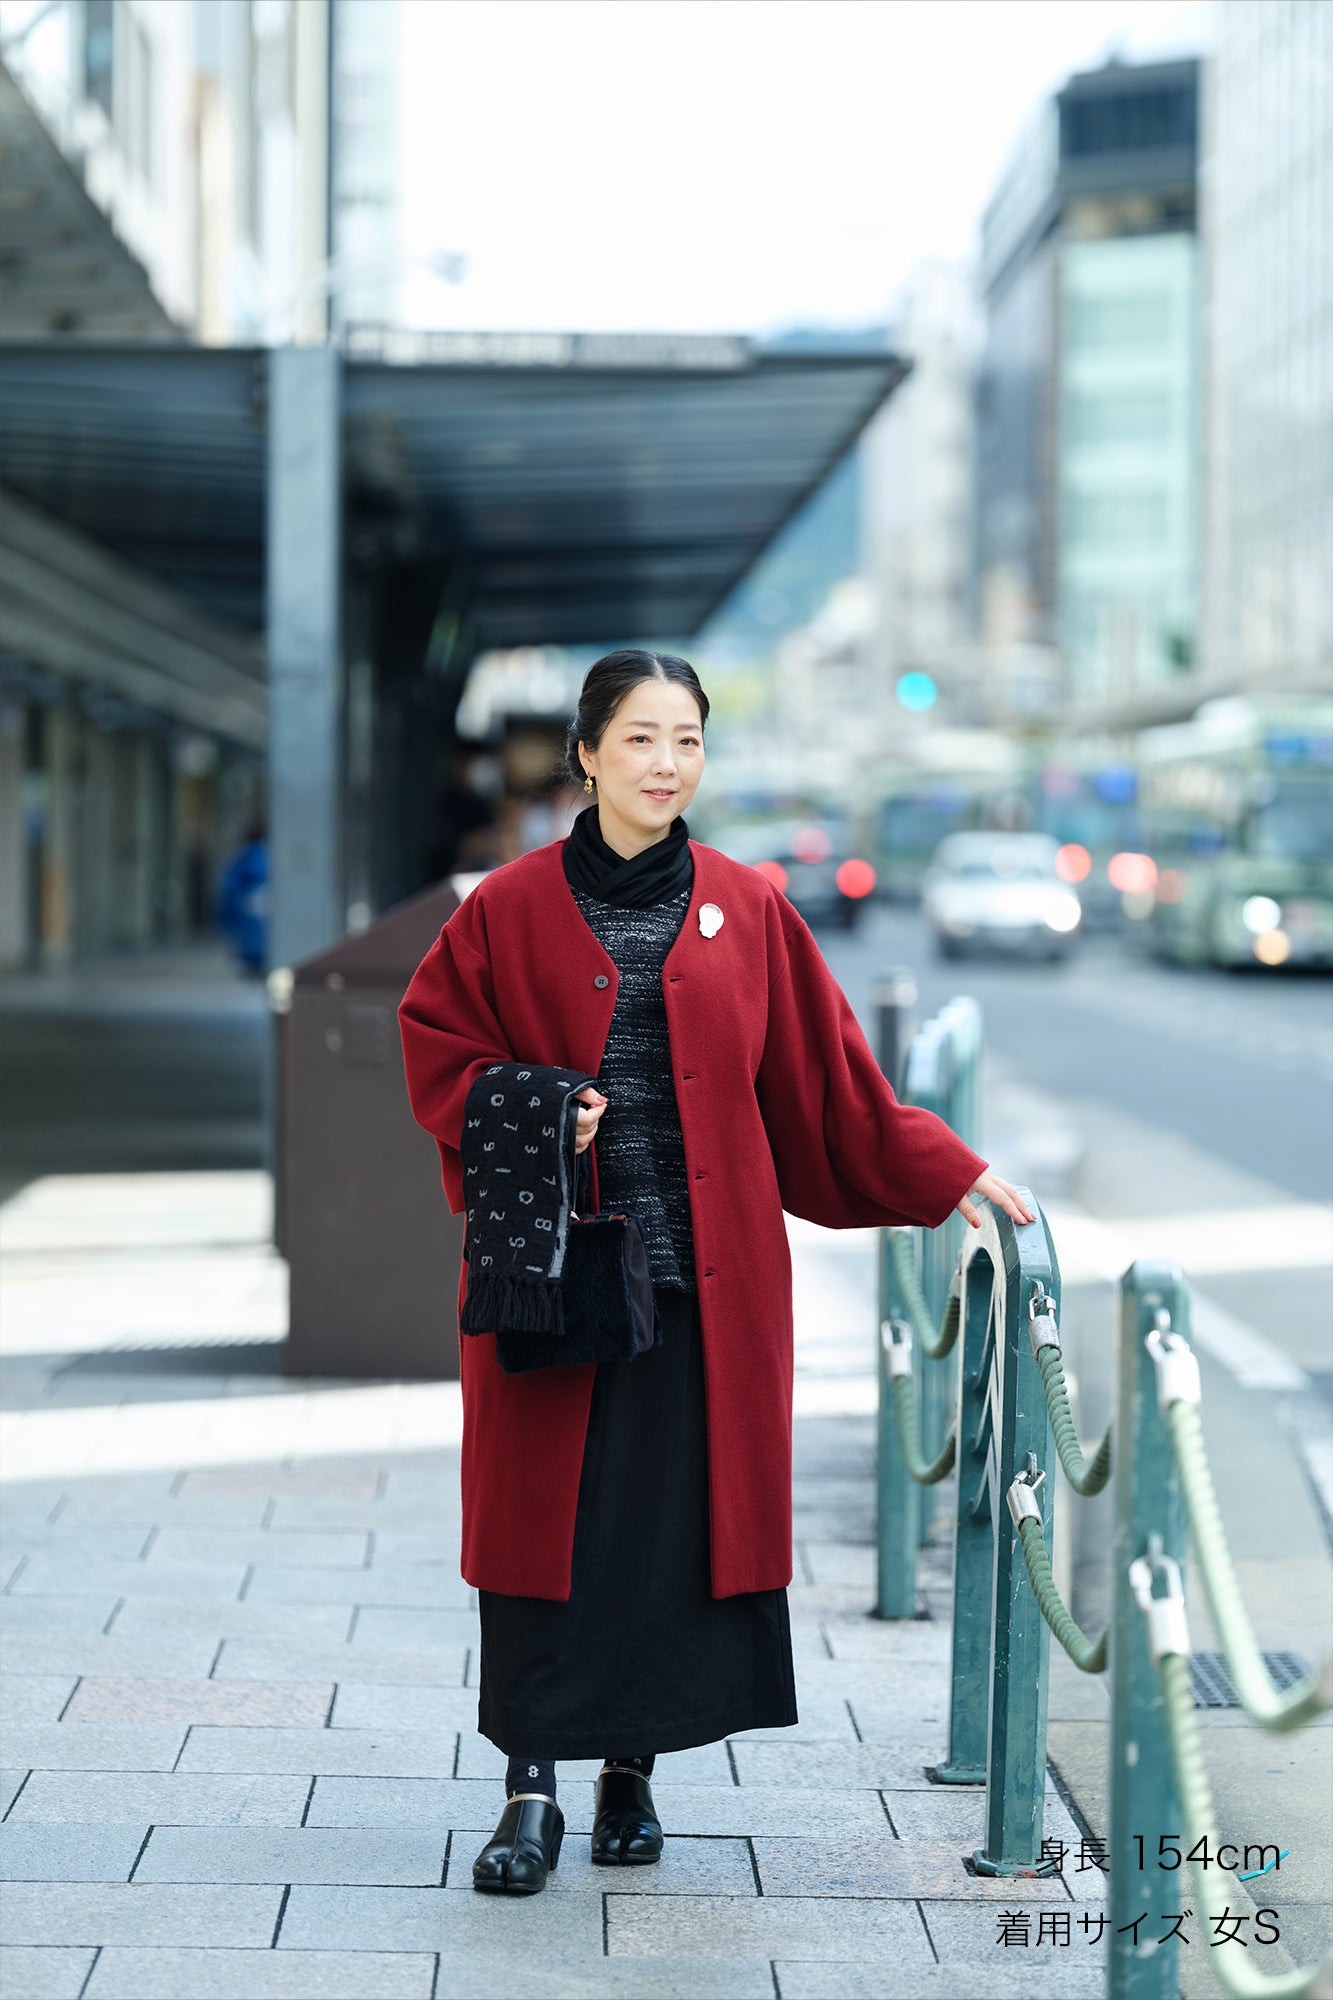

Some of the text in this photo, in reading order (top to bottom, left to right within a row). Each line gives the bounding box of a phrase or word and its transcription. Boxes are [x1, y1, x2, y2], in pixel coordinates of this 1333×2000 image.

[490, 1093, 505, 1107] 0
[528, 1096, 541, 1109] 4
[542, 1126, 555, 1138] 5
[524, 1144, 539, 1155] 3
[466, 1165, 478, 1177] 2
[542, 1175, 556, 1185] 7
[488, 1210, 506, 1221] 2
[481, 1255, 493, 1267] 6
[528, 1765, 539, 1778] 8
